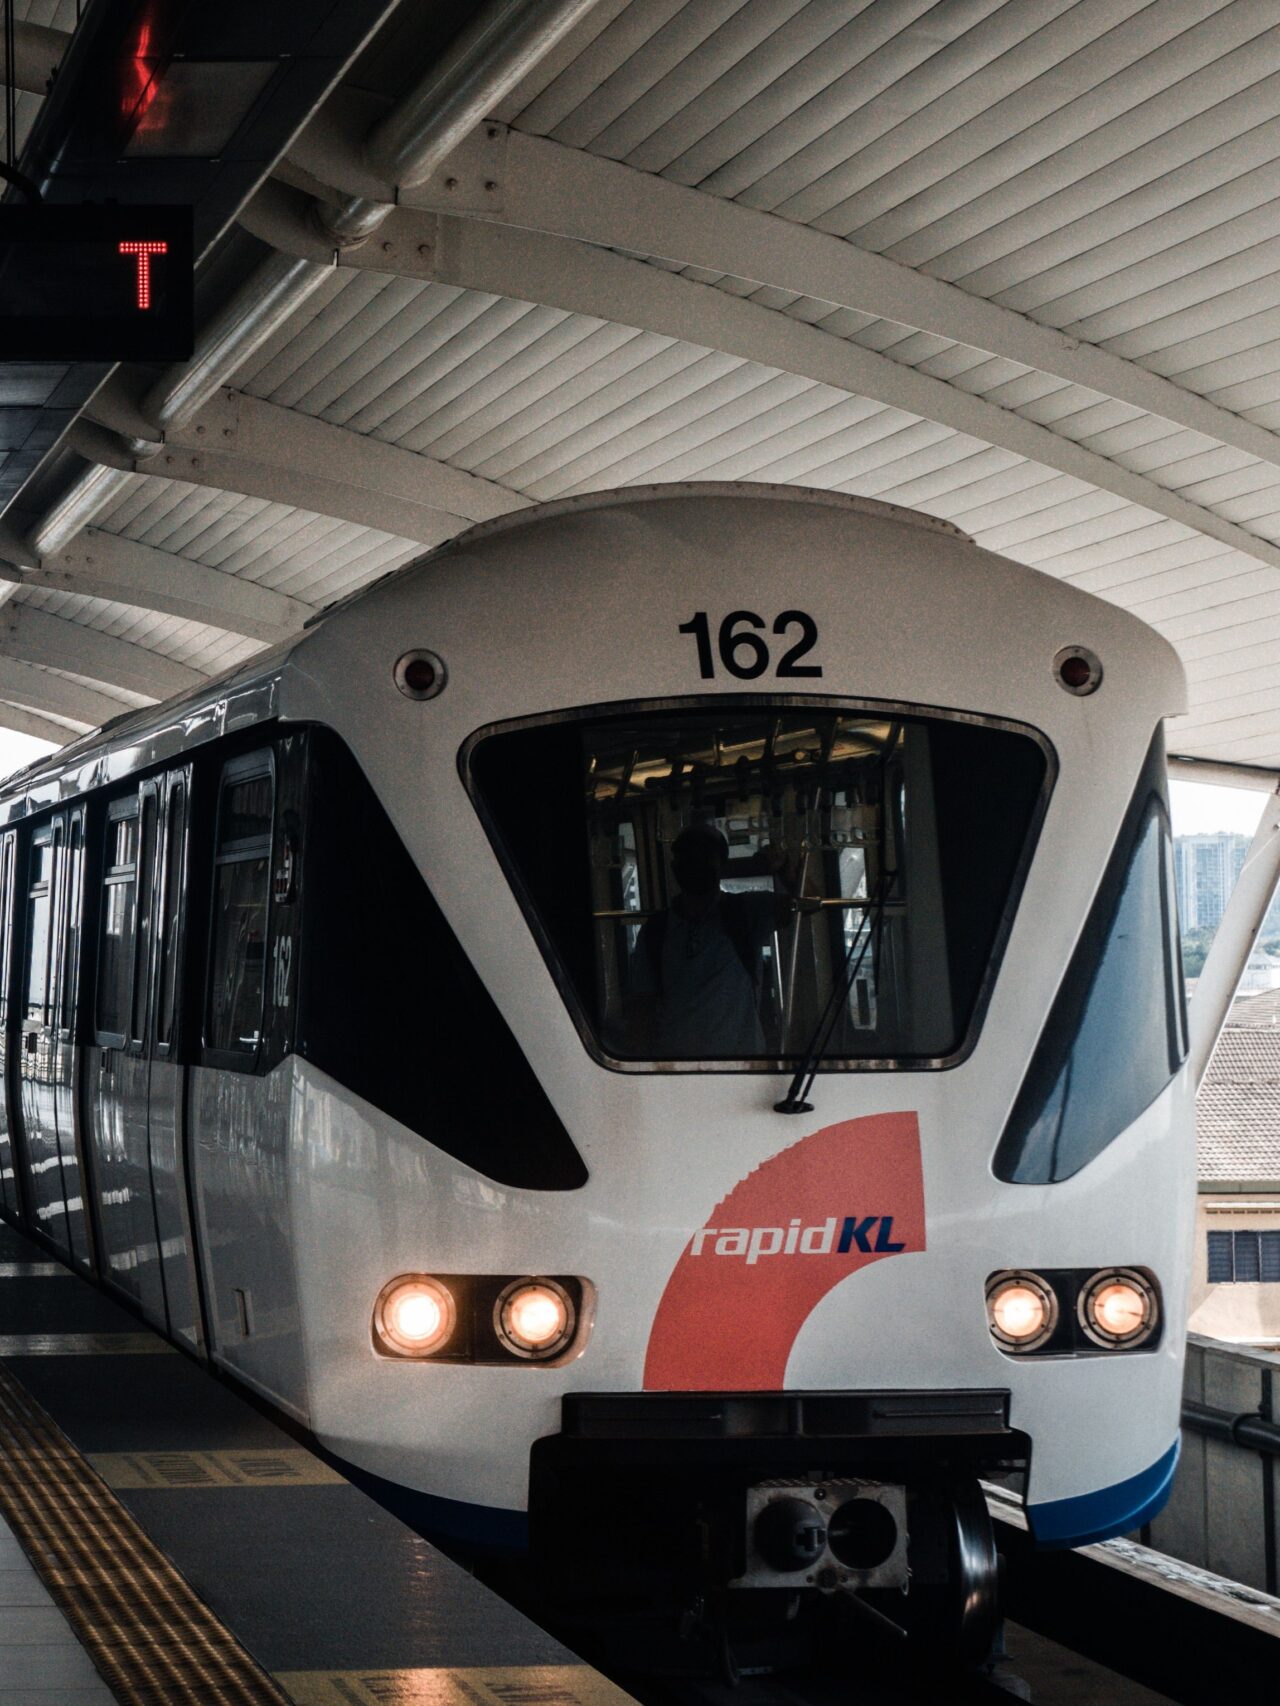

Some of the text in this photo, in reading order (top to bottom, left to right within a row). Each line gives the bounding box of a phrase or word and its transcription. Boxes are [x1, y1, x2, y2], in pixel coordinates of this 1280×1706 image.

[117, 241, 169, 311] T
[678, 610, 824, 680] 162
[272, 935, 292, 1007] 162
[688, 1216, 906, 1265] rapidKL
